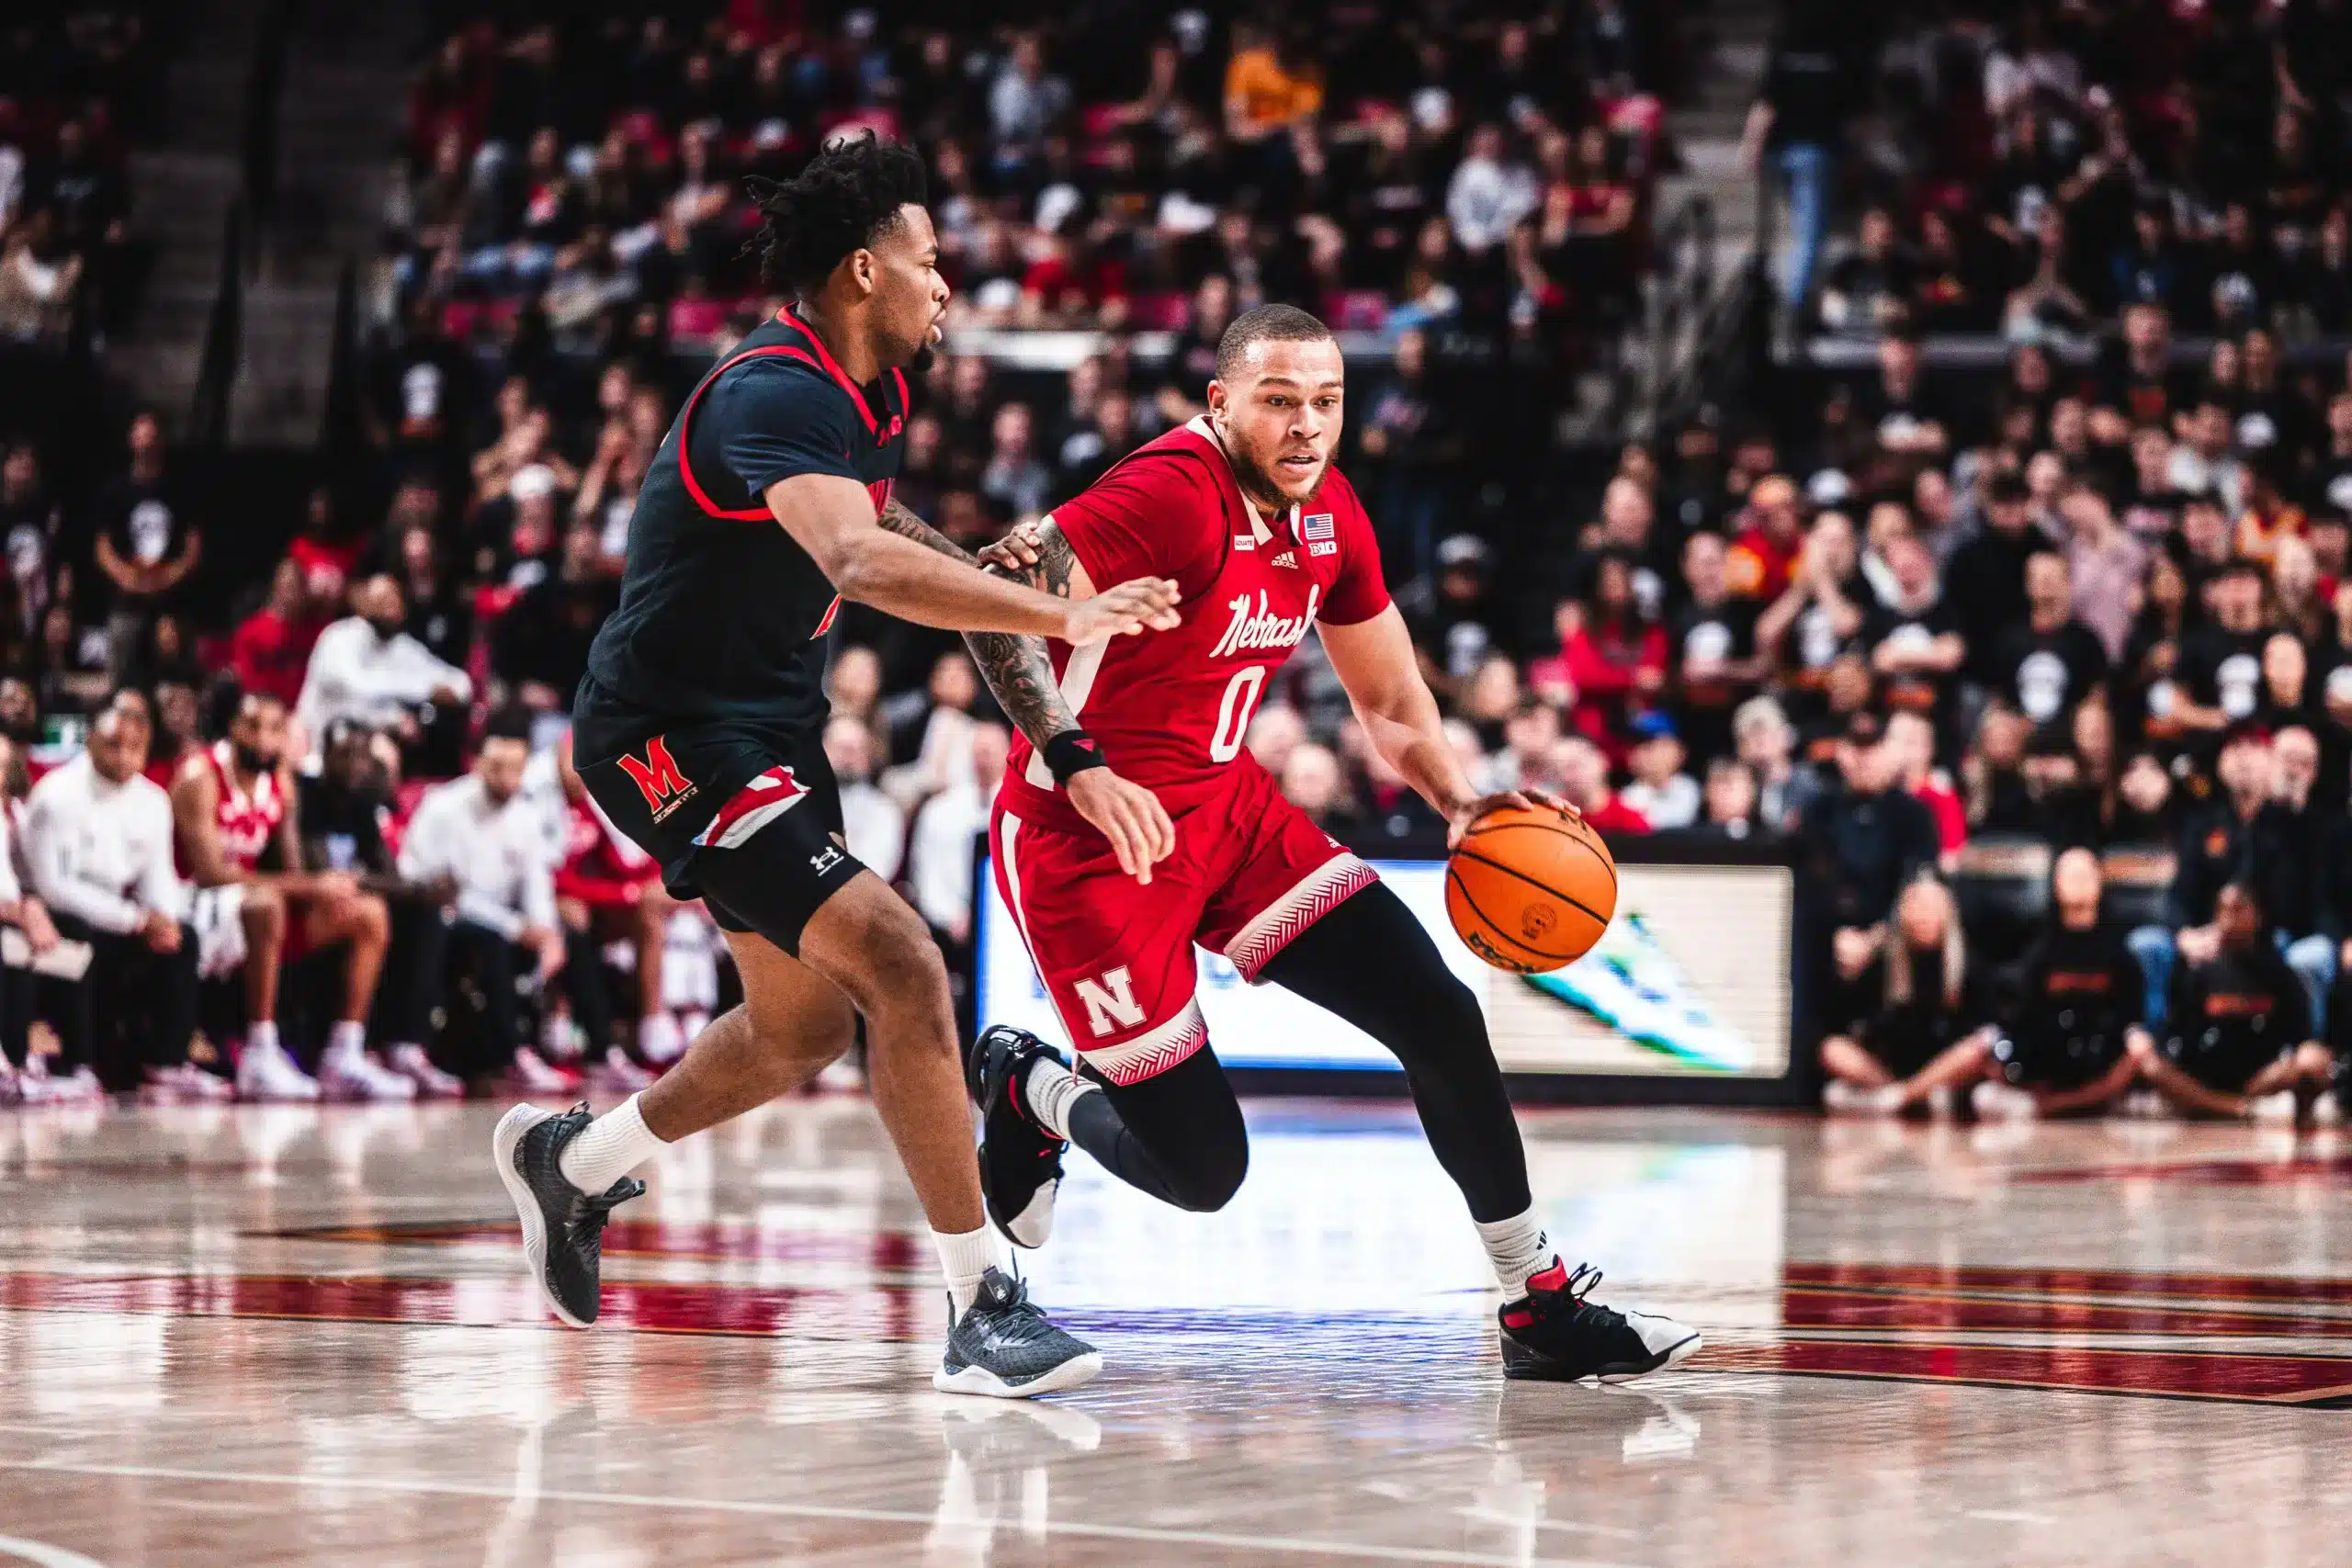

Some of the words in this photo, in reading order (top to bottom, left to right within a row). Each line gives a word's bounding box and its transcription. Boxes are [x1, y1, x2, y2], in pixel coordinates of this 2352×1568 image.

[1272, 559, 1299, 570] adidas
[1210, 665, 1266, 763] 0
[616, 734, 694, 815] M
[1073, 964, 1147, 1038] N
